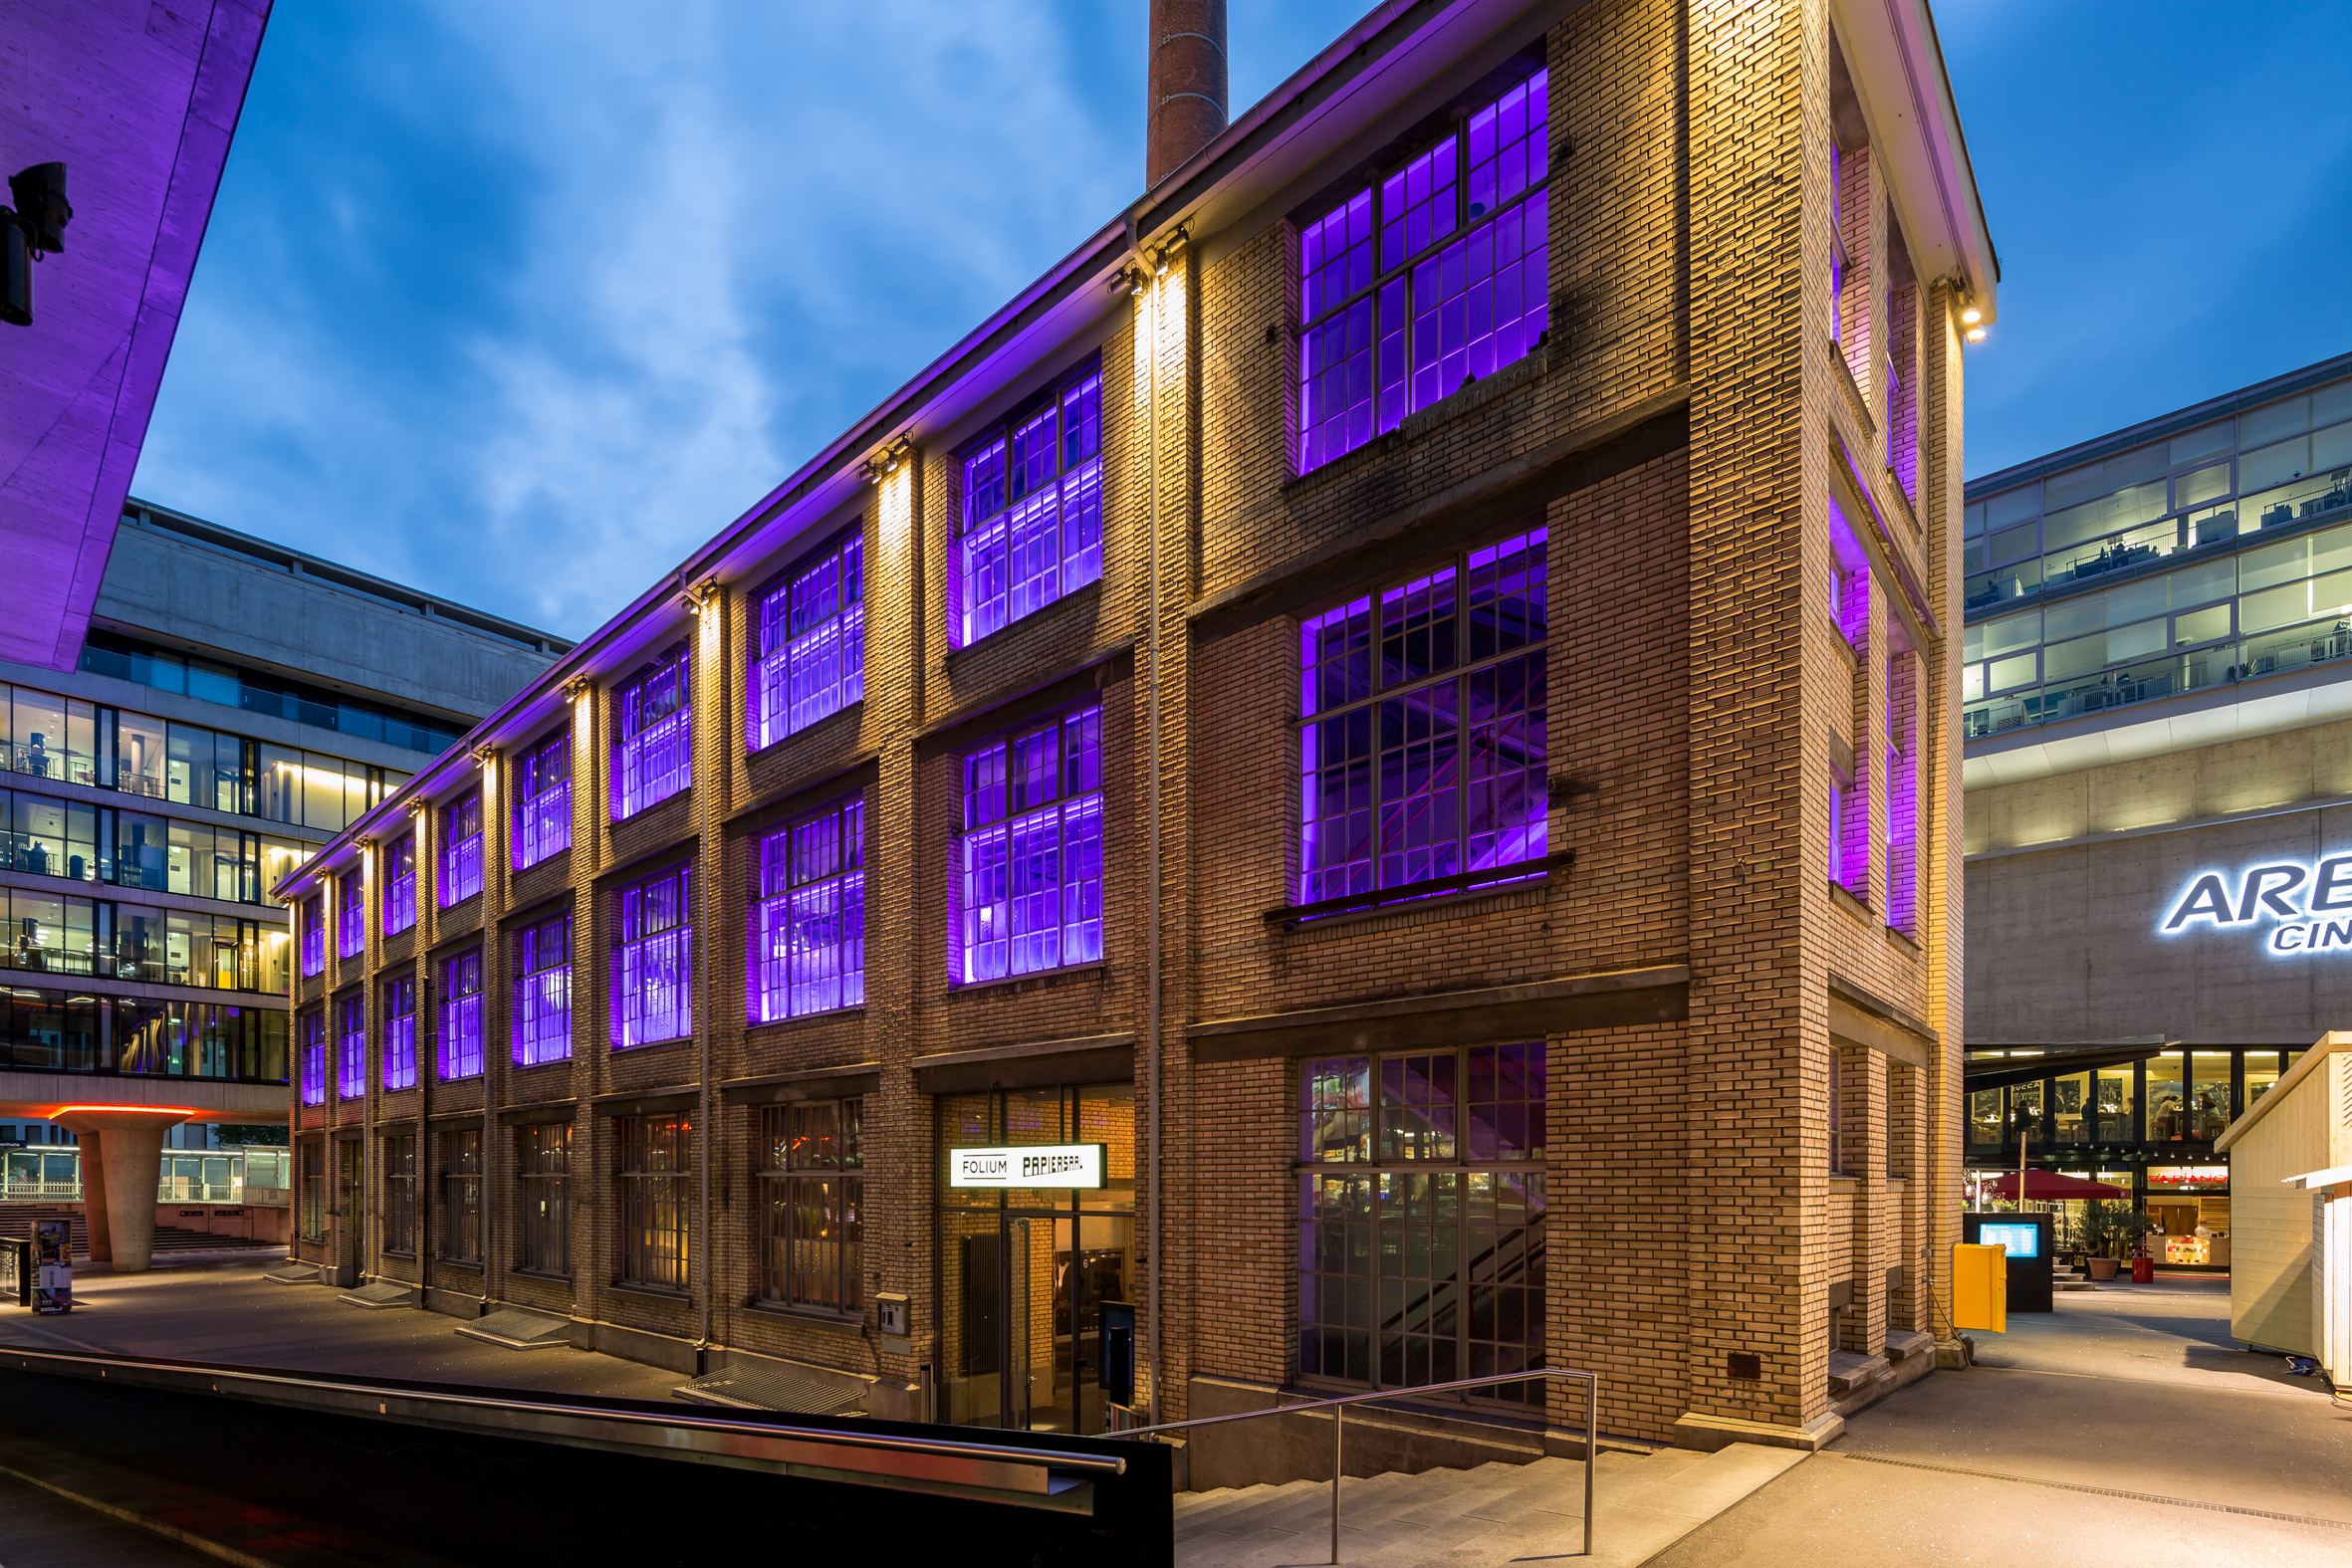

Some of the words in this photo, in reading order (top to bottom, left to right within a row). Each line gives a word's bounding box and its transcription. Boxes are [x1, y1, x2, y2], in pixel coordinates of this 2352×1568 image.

[2165, 856, 2352, 930] ARE
[963, 1160, 1008, 1174] FOLIUM
[1023, 1155, 1083, 1177] PAPIERSAAL
[1083, 1259, 1088, 1268] 6
